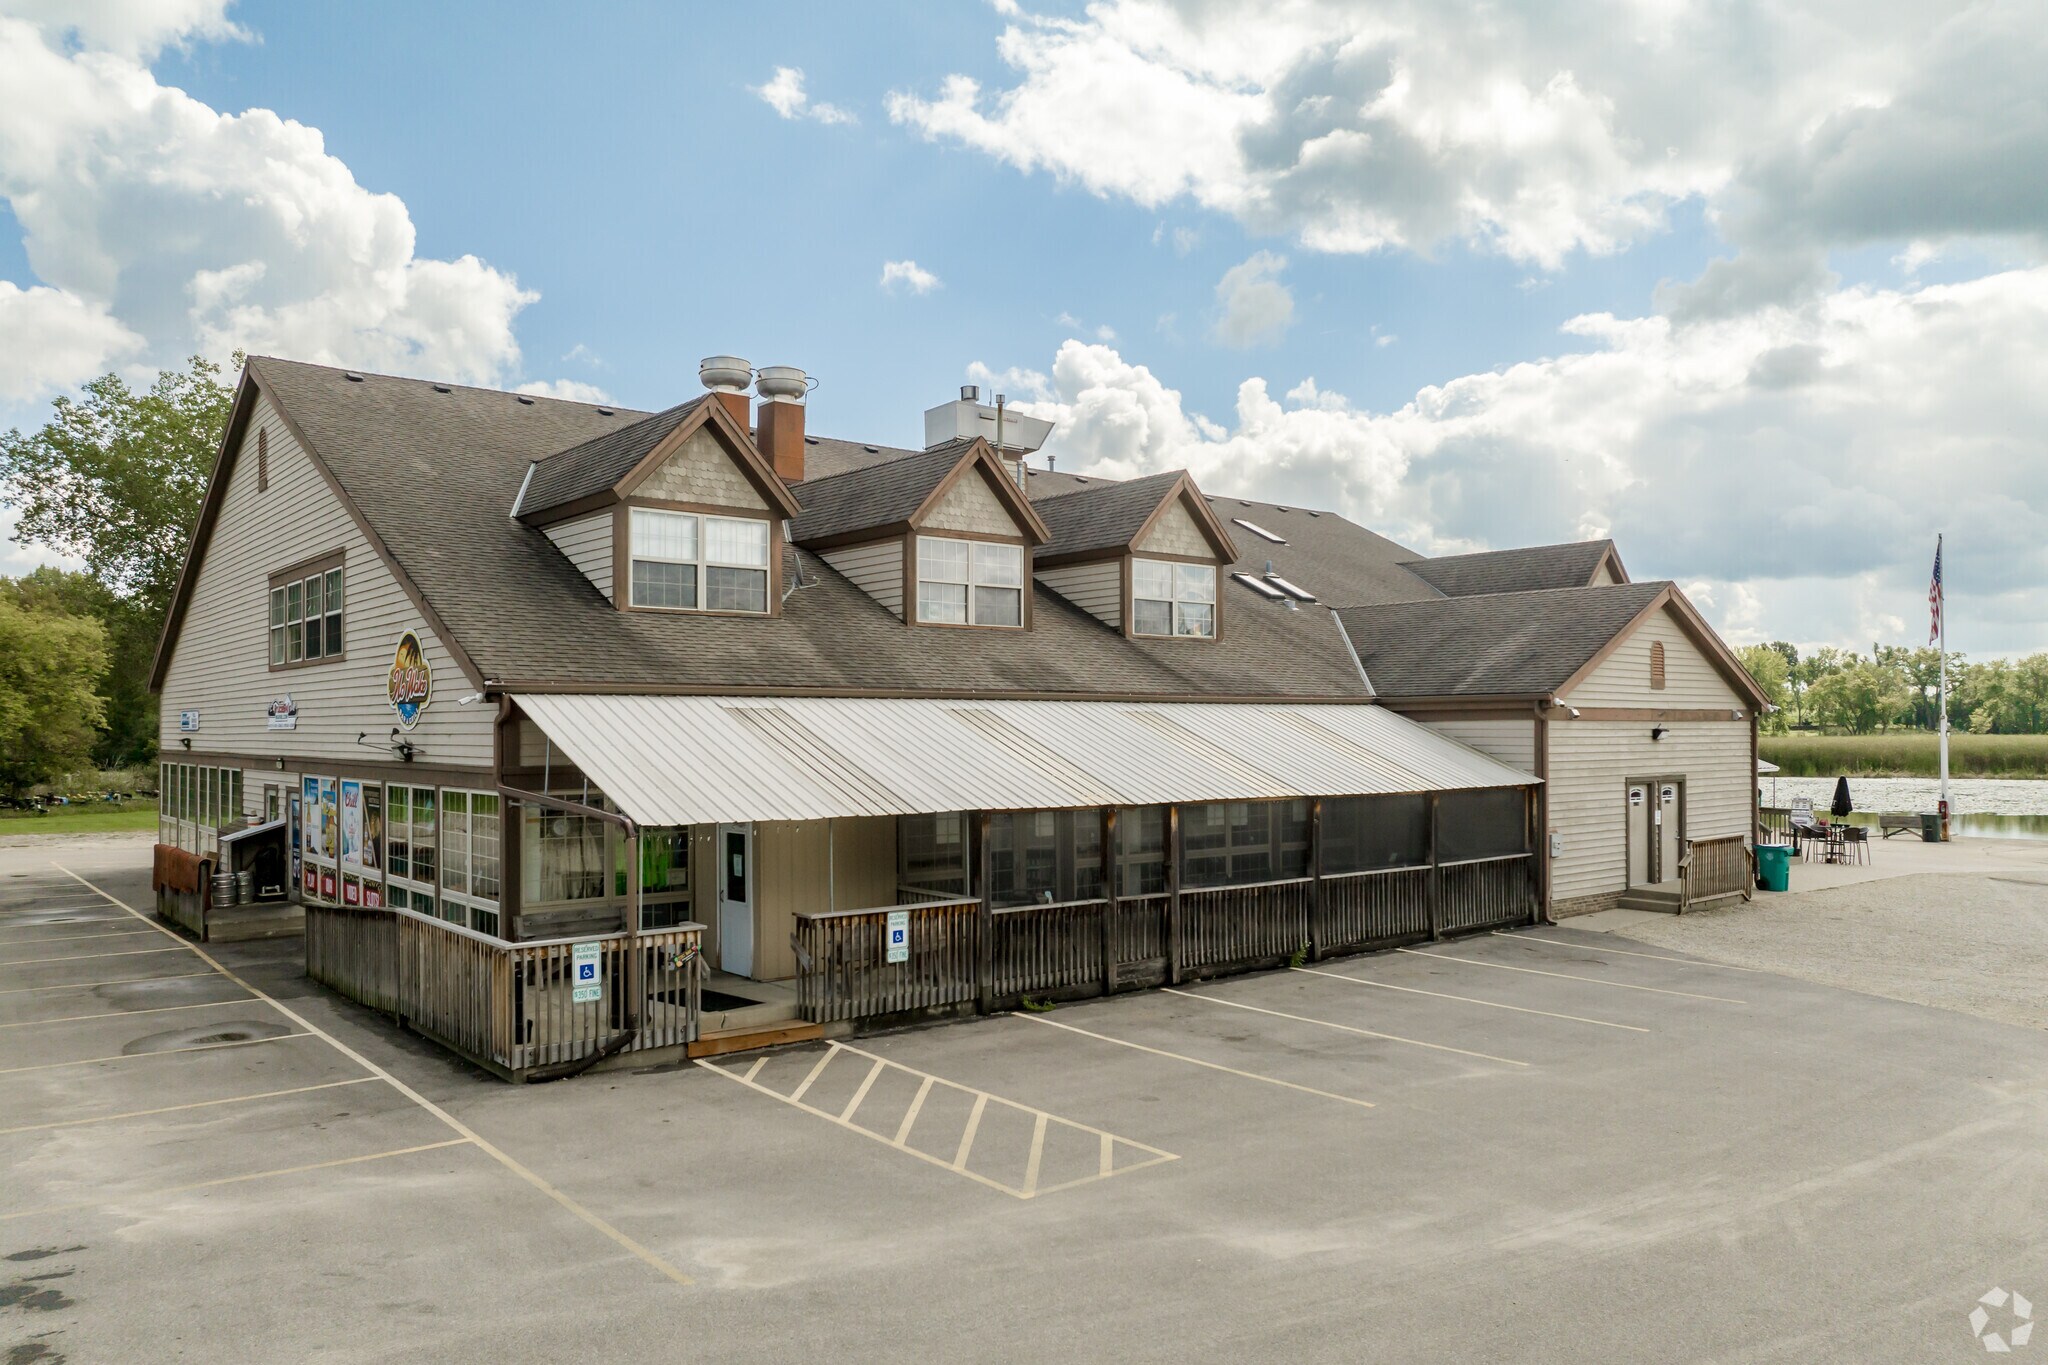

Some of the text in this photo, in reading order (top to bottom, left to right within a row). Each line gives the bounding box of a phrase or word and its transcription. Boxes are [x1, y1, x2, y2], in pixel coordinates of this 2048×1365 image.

[391, 665, 428, 704] No Wake
[345, 791, 359, 808] Chill
[574, 988, 600, 999] $350 FINE
